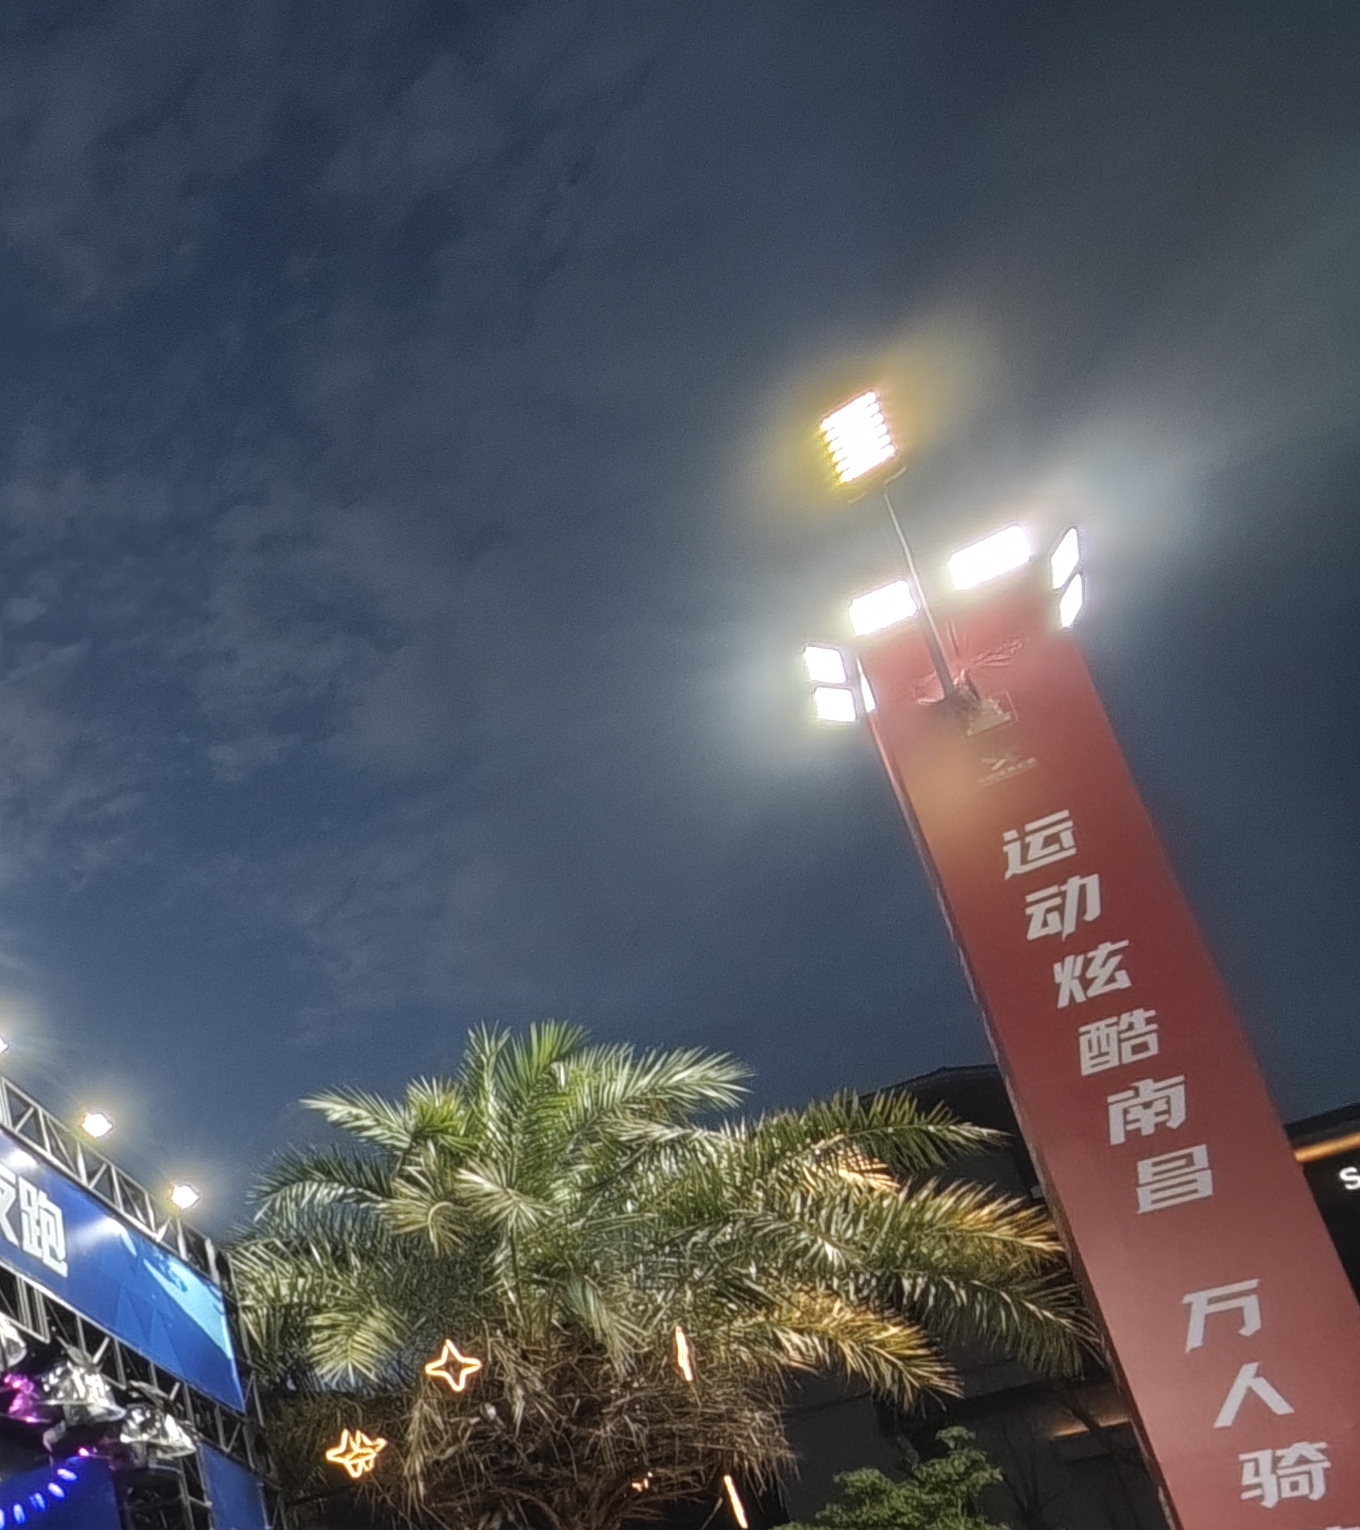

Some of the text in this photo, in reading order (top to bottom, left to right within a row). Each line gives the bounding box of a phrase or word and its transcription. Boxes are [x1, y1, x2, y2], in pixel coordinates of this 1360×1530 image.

[1002, 809, 1214, 1213] 运动炫酷南昌
